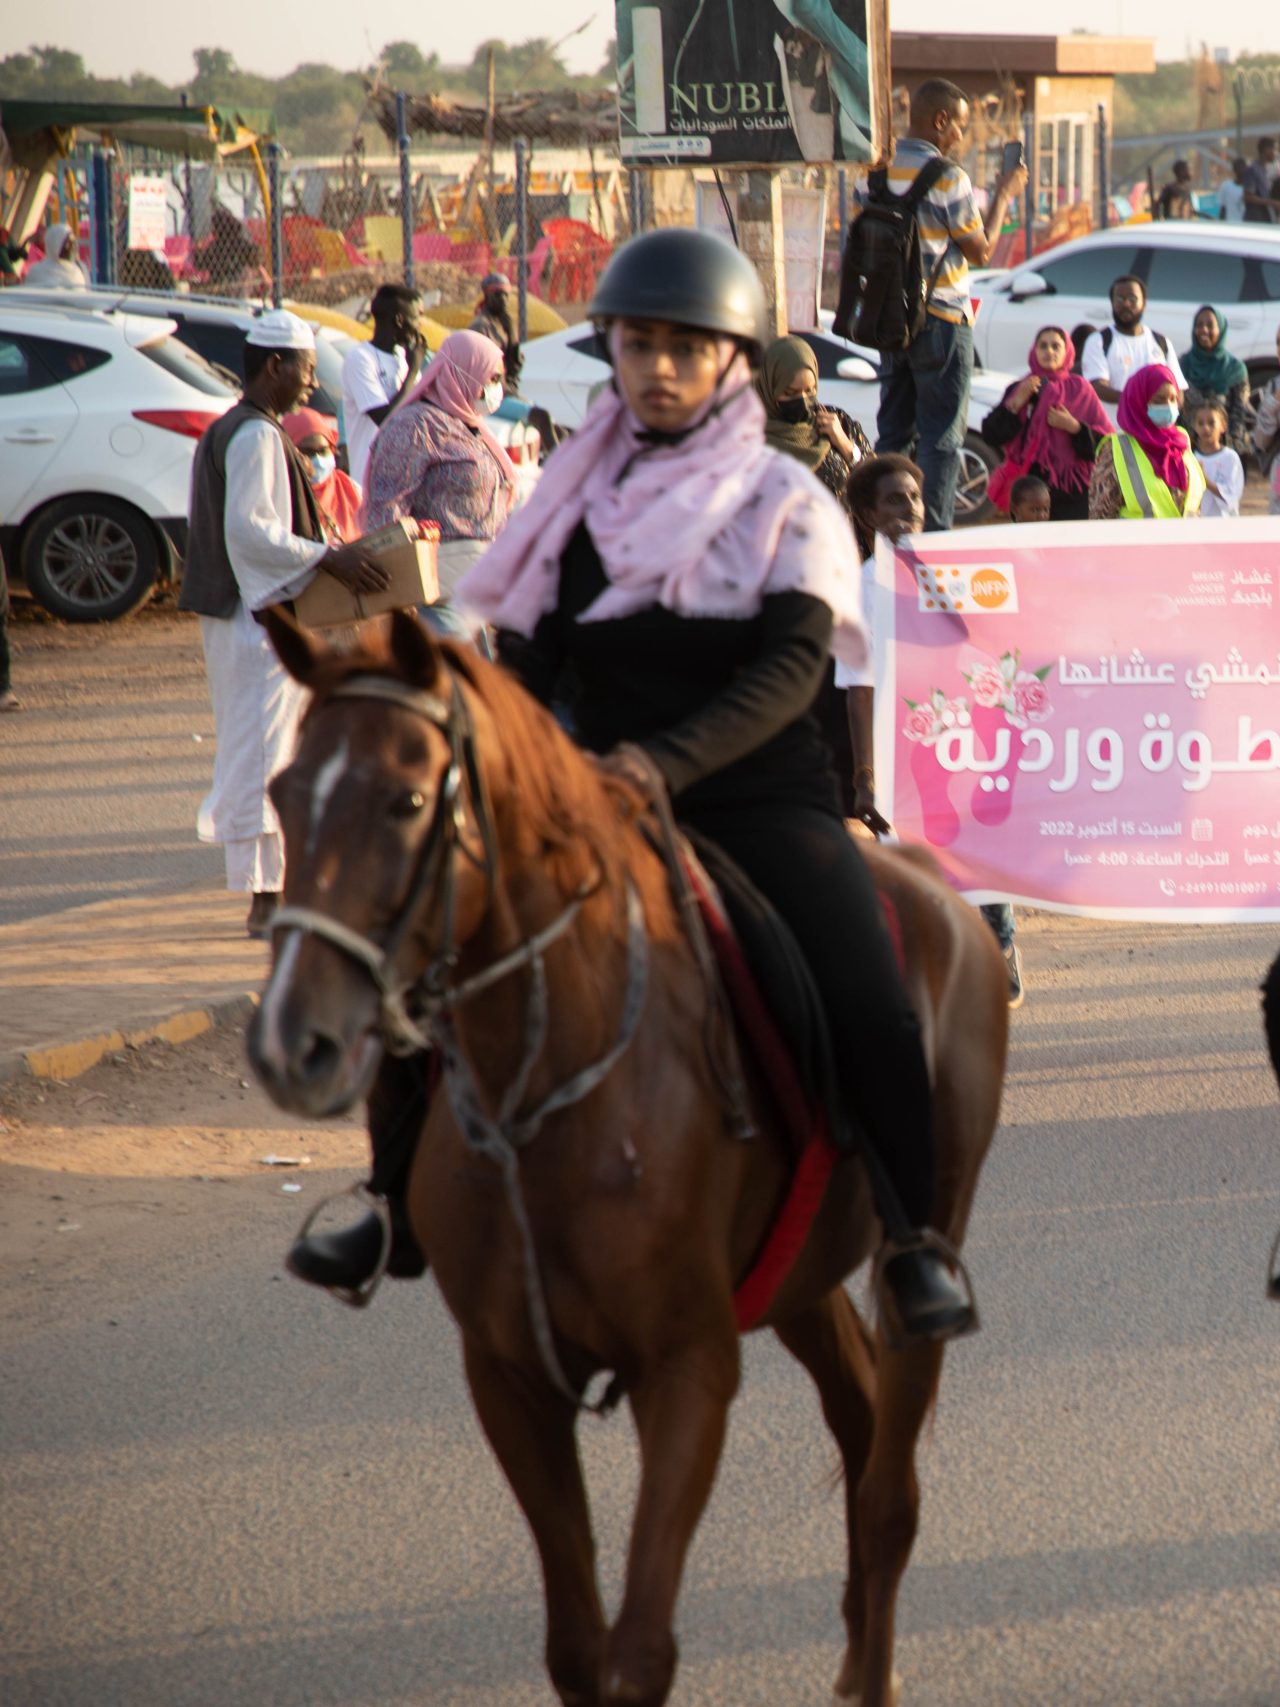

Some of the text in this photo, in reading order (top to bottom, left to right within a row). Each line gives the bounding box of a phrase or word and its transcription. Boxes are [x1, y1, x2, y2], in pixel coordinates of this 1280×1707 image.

[668, 82, 788, 114] NUBI
[1058, 647, 1175, 685] عشانها
[934, 709, 1124, 792] وردية
[1039, 821, 1074, 836] 2022
[1122, 821, 1135, 836] 15
[1138, 821, 1182, 838] السبت
